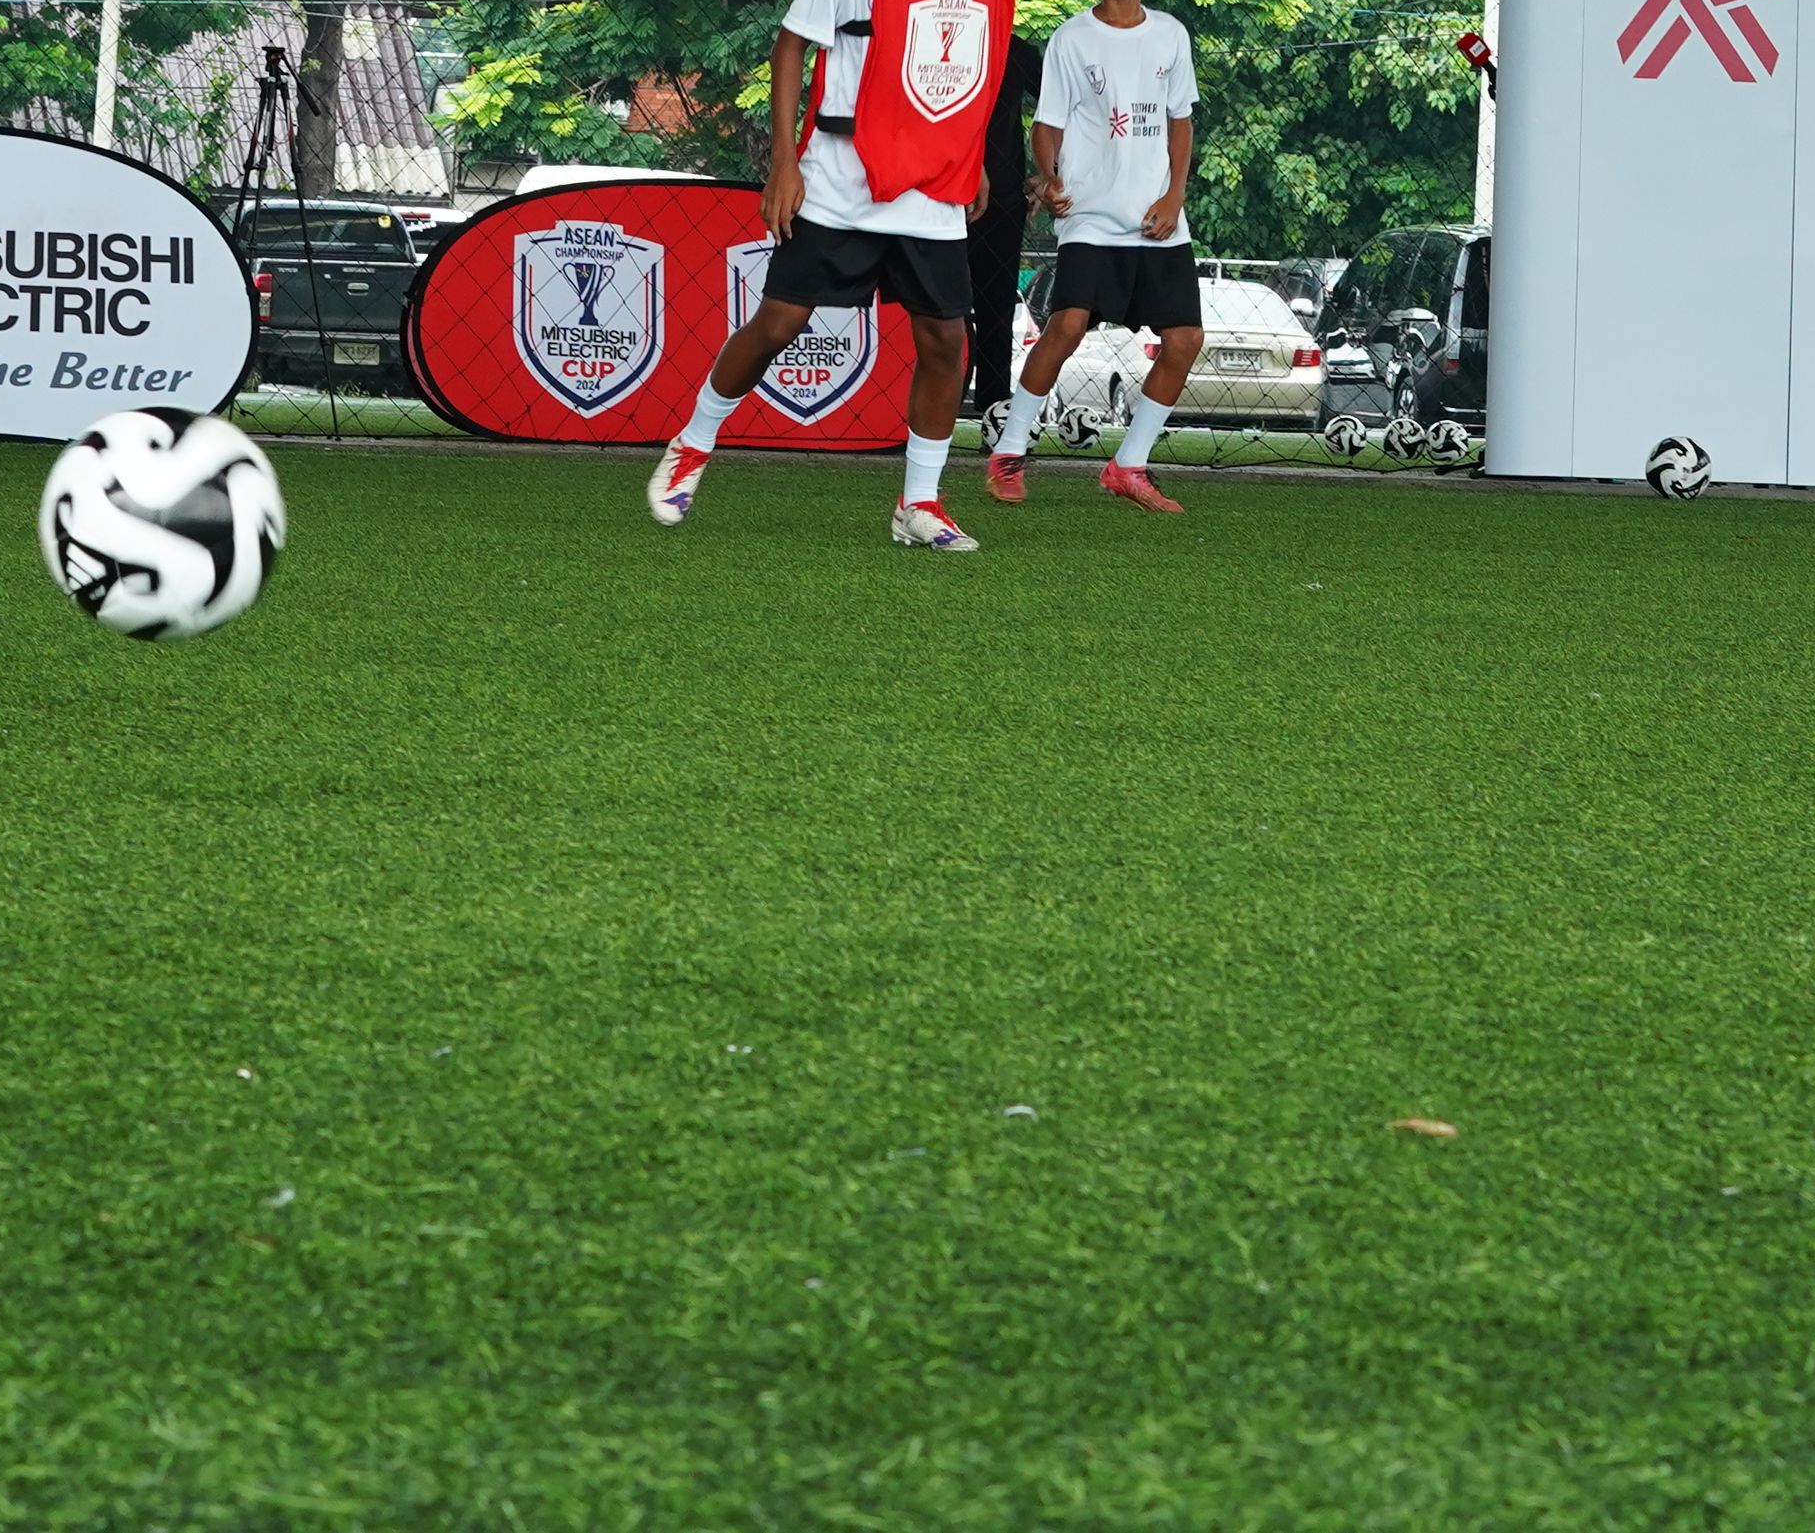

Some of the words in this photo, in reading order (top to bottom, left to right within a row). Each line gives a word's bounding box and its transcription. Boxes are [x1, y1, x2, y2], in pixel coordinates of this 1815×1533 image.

[917, 63, 972, 75] MITSUBISHI
[919, 74, 966, 86] ELECTRIC
[925, 85, 956, 97] CUP
[564, 227, 615, 247] ASEAN
[554, 247, 625, 262] CHAMPIONSHIP
[541, 326, 637, 346] MITSUBISHI
[547, 342, 631, 361] ELECTRIC
[773, 352, 845, 367] LECTRIC
[48, 351, 193, 393] Better
[561, 359, 616, 379] CUP
[778, 368, 831, 386] CUP
[575, 380, 601, 391] 2024
[792, 387, 817, 398] 2024
